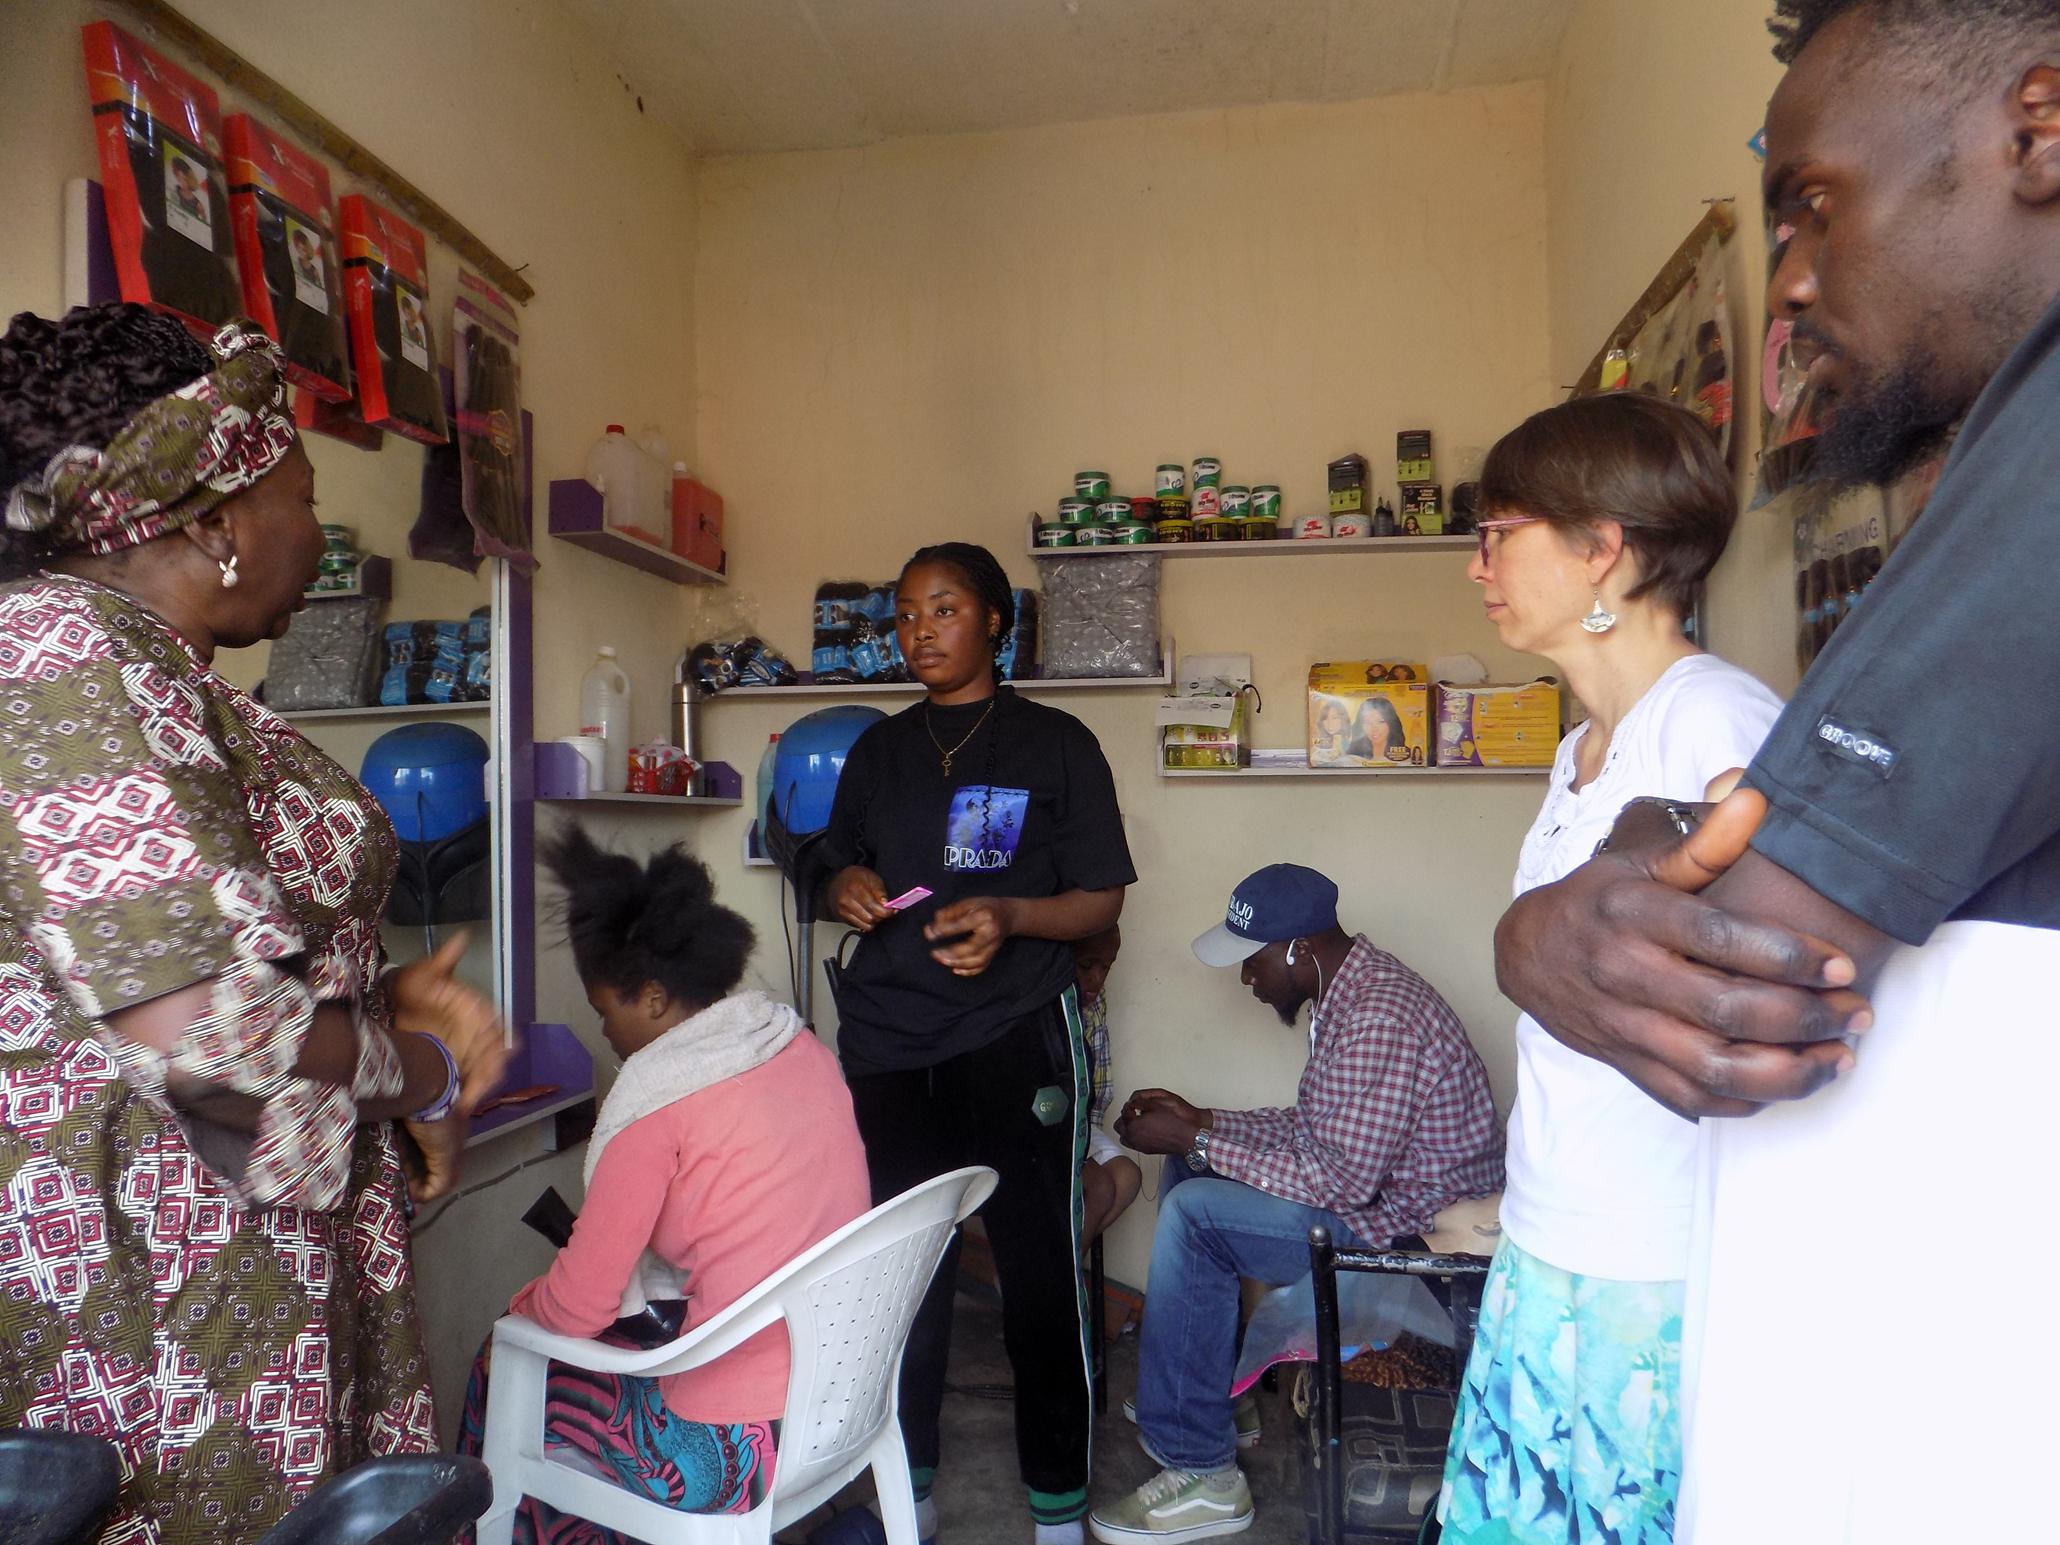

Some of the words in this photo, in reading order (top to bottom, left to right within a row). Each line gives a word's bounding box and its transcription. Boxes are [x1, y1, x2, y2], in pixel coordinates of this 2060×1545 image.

[1819, 724, 1893, 766] GROOVE
[944, 846, 1012, 869] PRADA
[1228, 909, 1251, 931] IDENT
